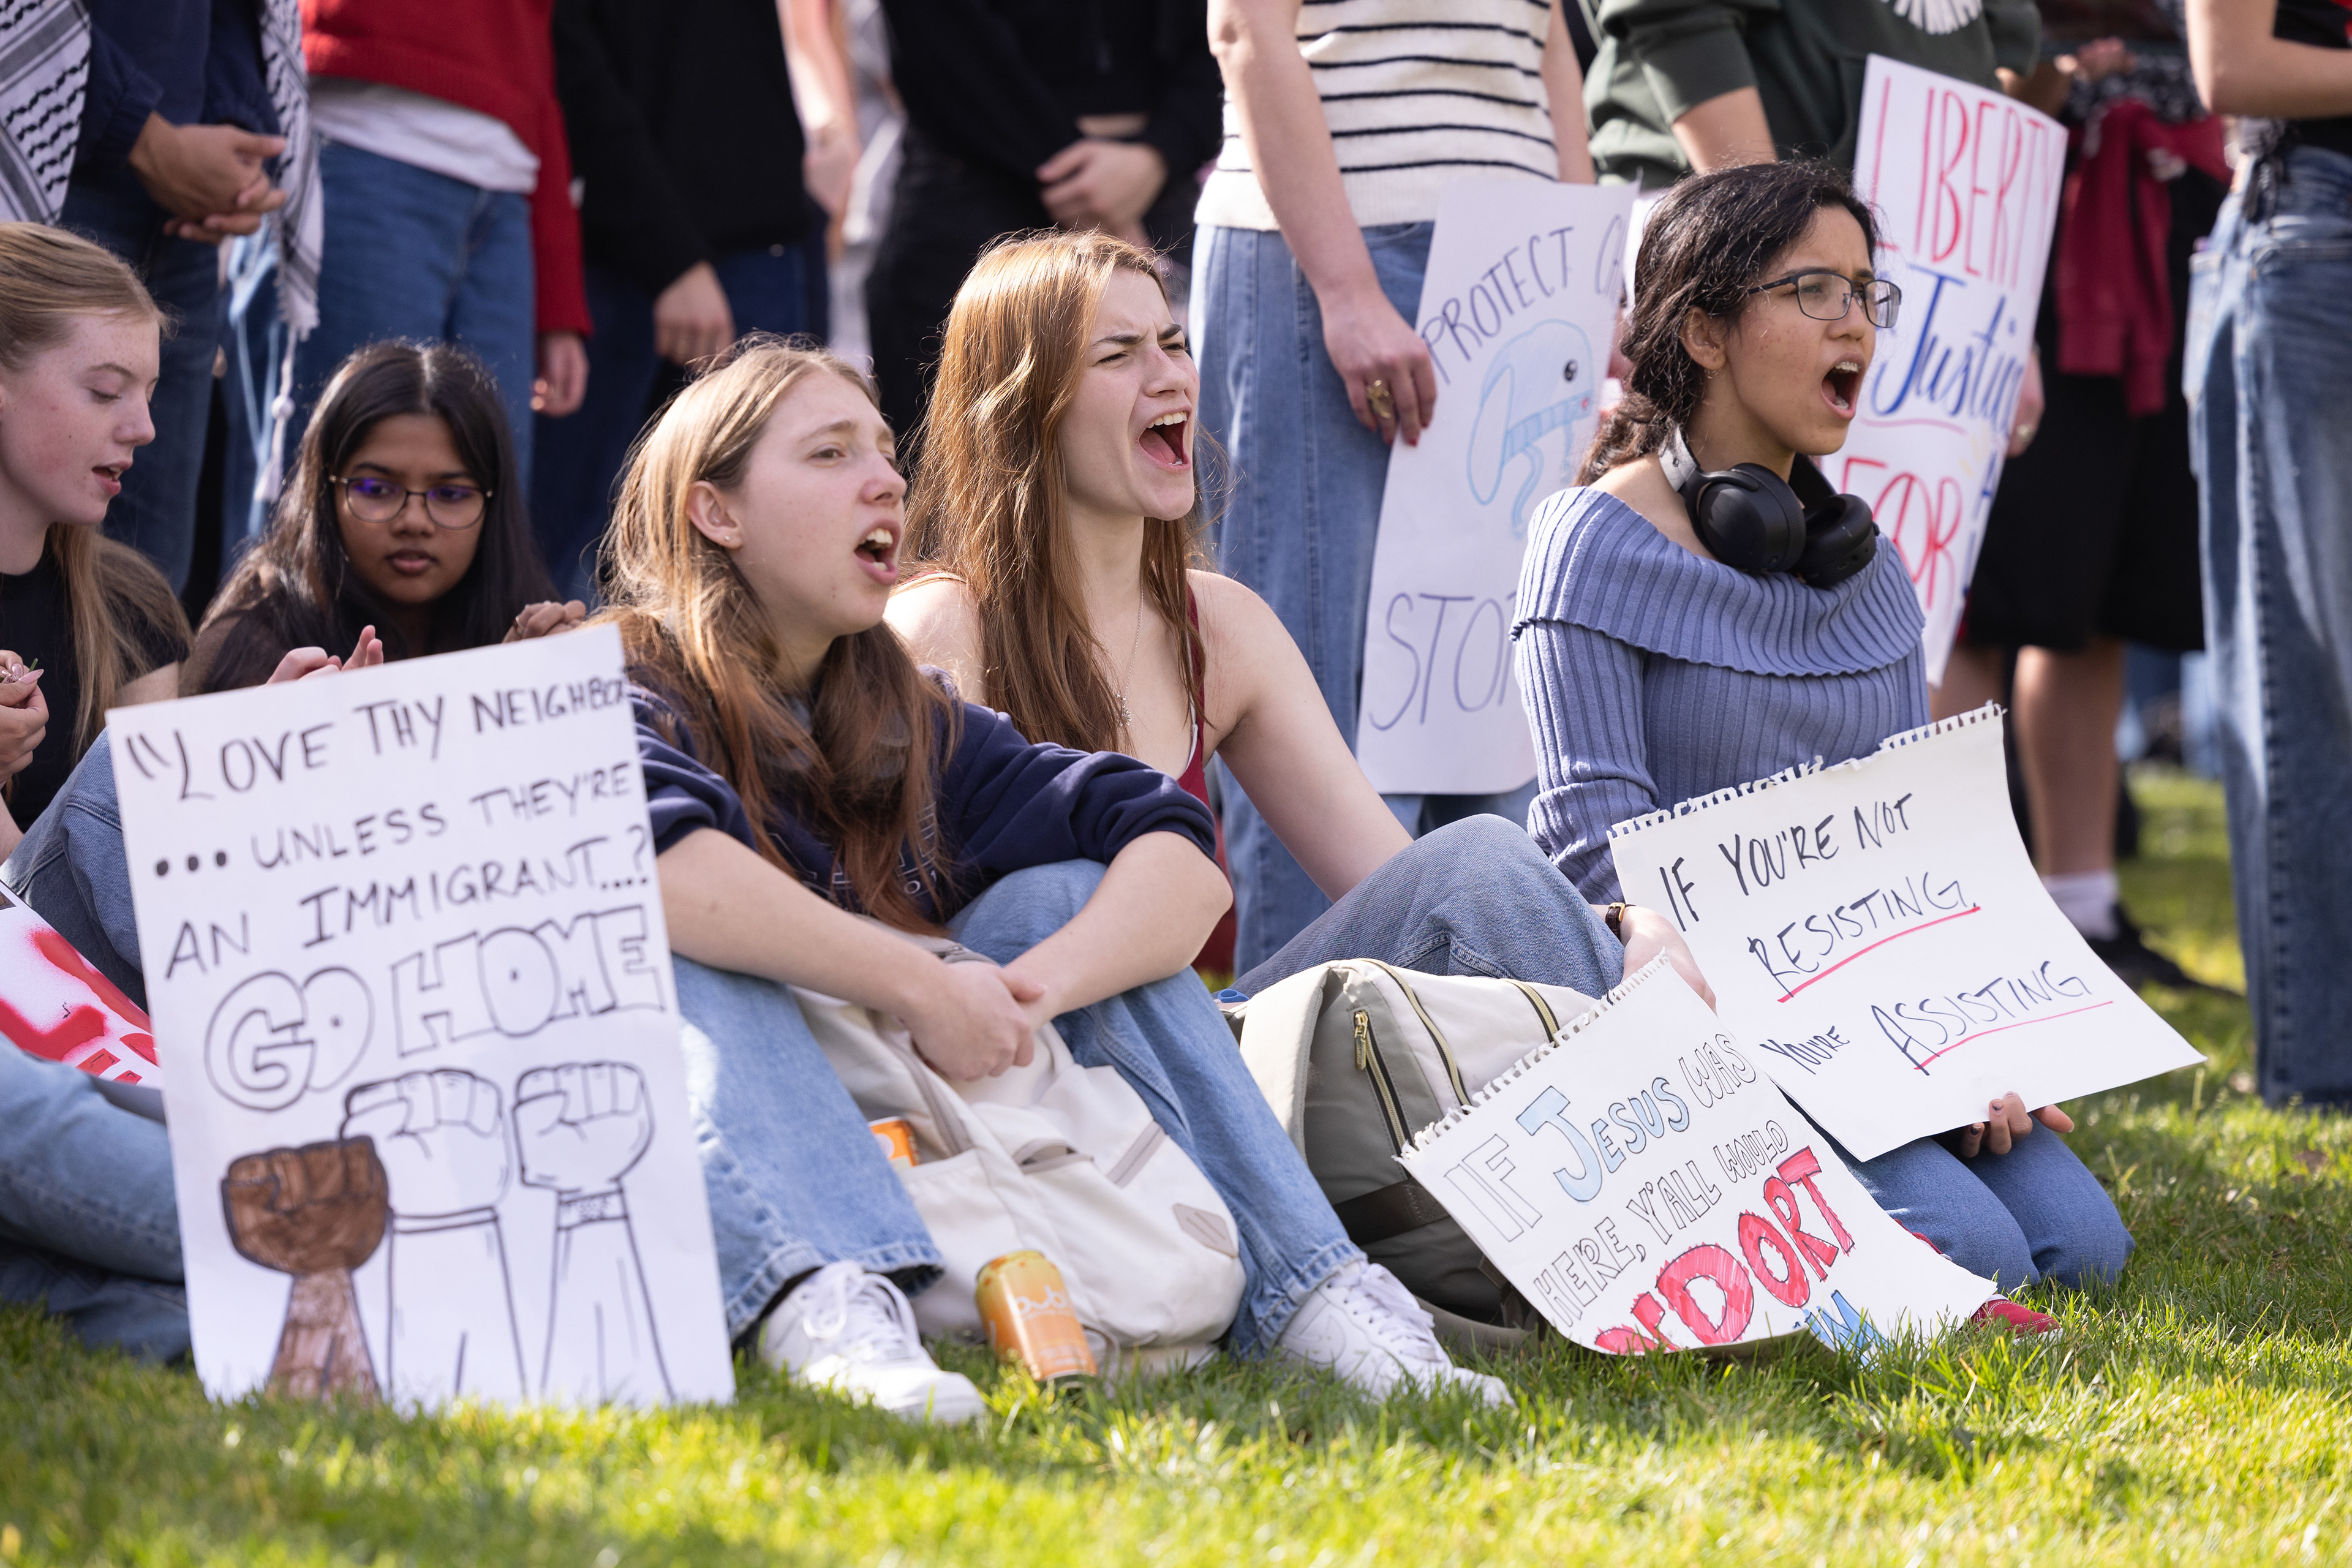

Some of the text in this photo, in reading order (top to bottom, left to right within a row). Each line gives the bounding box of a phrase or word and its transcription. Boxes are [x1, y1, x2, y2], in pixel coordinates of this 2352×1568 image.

[1421, 227, 1575, 385] PROTECT
[353, 696, 441, 761] THY
[469, 761, 631, 827] THEY'RE
[1659, 793, 1913, 932] IF YOU'RE NOT
[165, 911, 250, 979] AN
[203, 904, 666, 1112] GO HOME
[1871, 961, 2092, 1076] ASSISTING
[1444, 1033, 1757, 1242] IF JESUS WAS
[1533, 1120, 1788, 1327] HERE, Y'ALL WOULD
